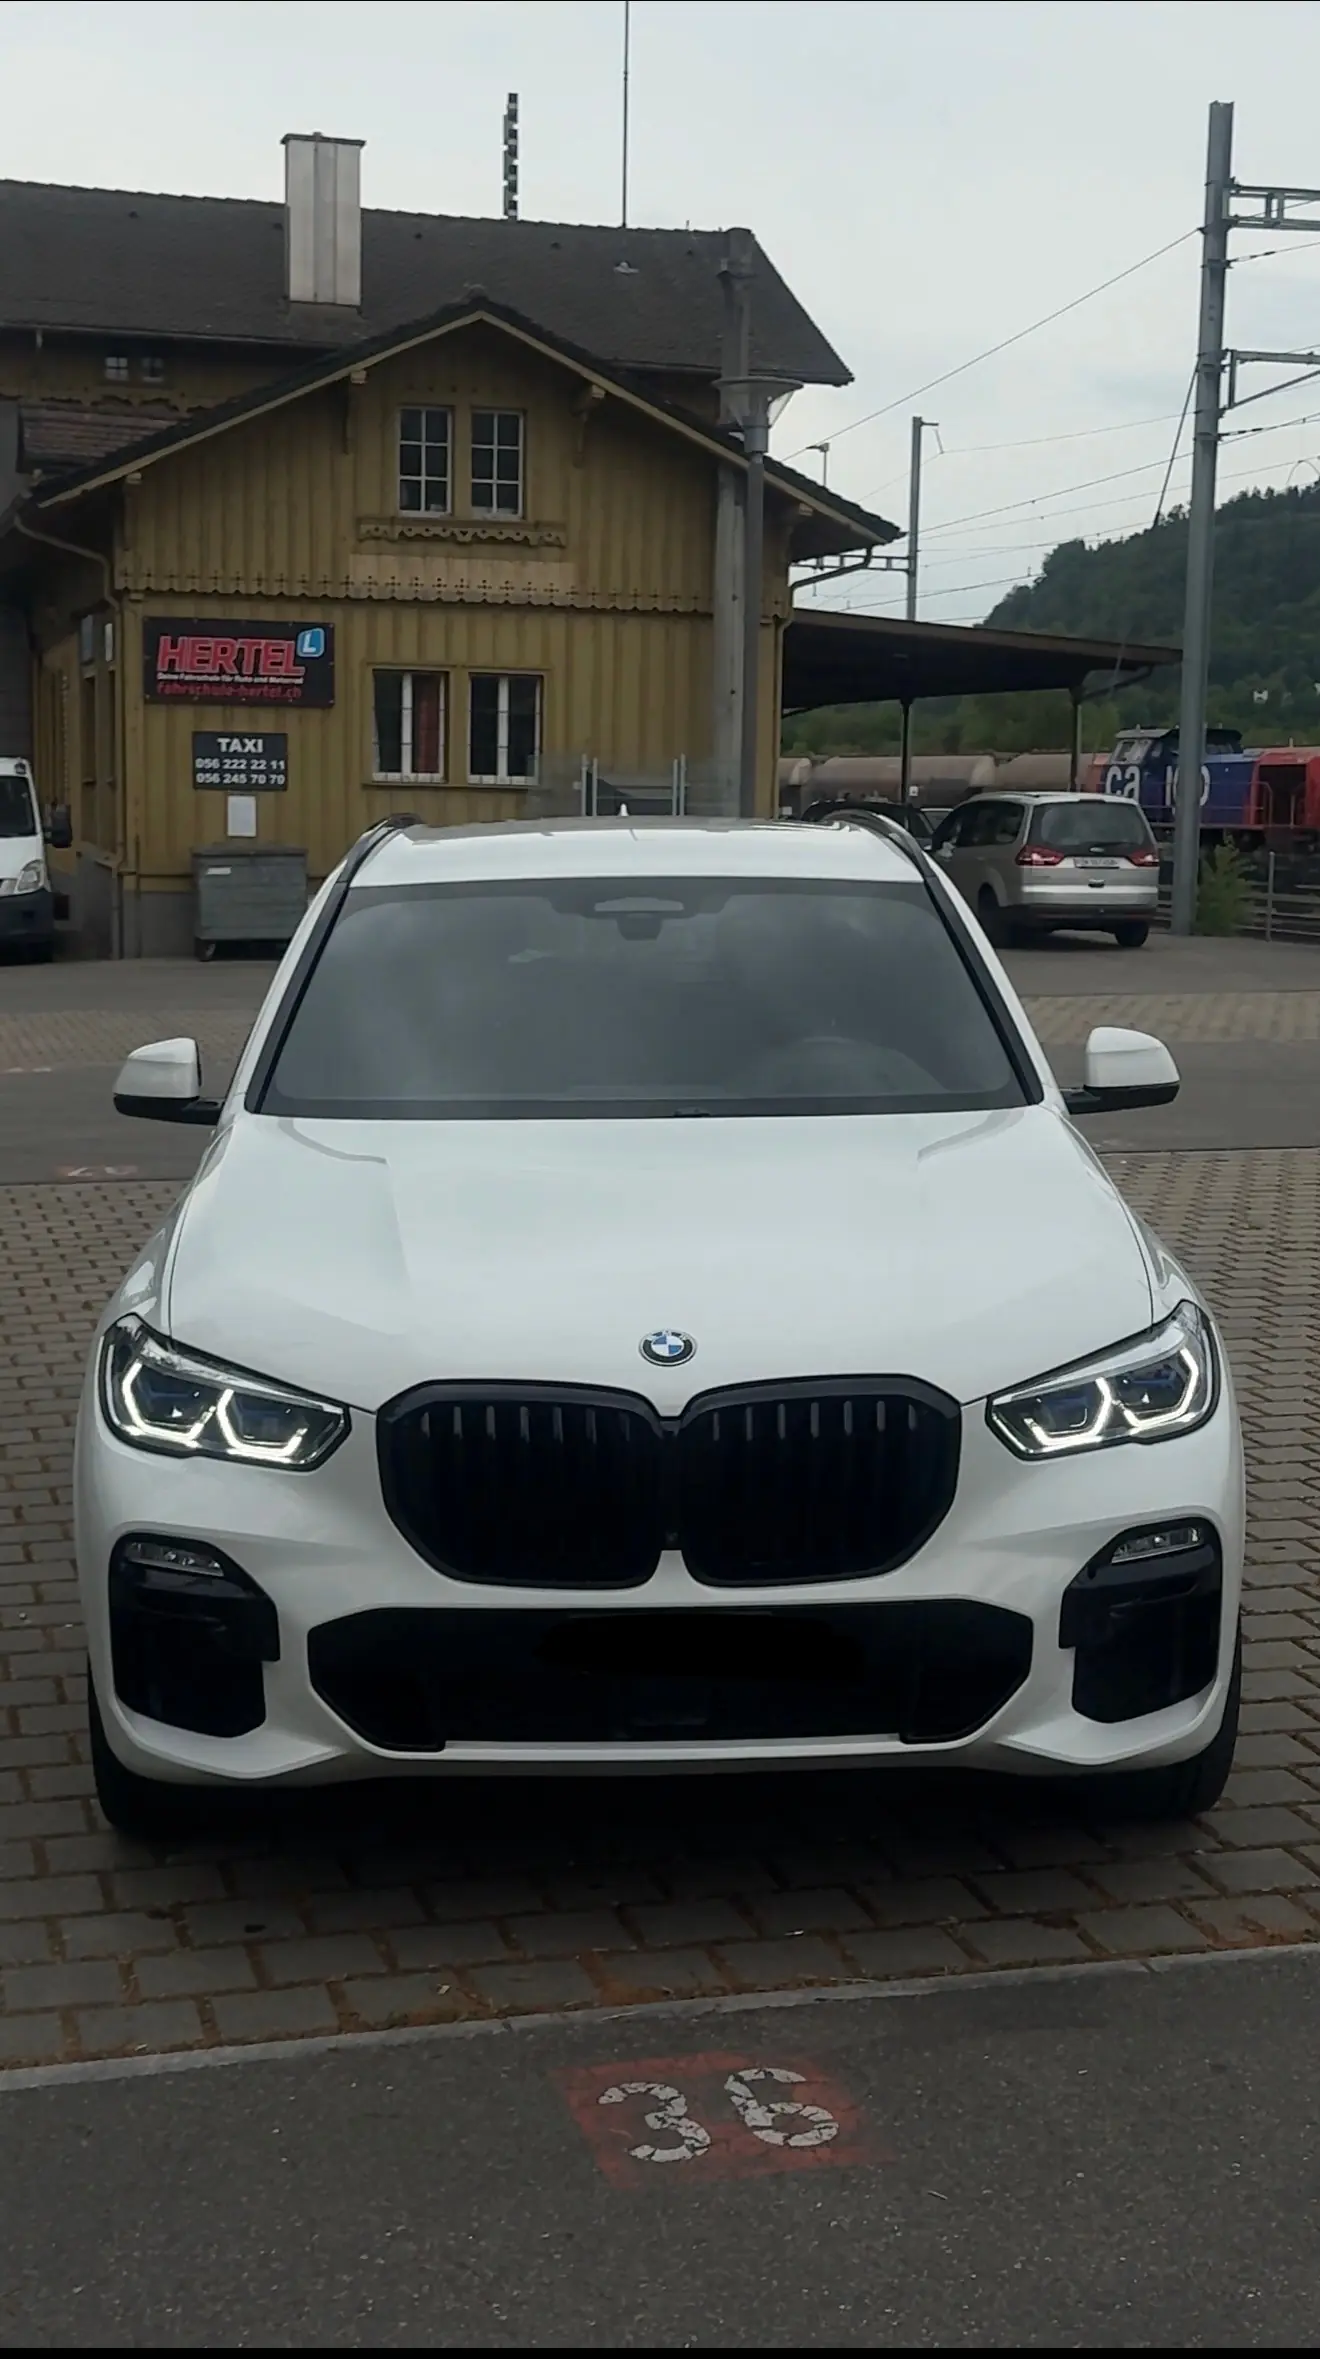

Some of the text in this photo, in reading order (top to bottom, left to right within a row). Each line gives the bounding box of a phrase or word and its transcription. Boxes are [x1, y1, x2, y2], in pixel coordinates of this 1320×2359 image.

[302, 633, 316, 653] L
[157, 635, 305, 676] HERTEL
[217, 737, 263, 753] TAXI
[195, 758, 285, 770] 056 222 22 11
[196, 772, 286, 785] 056 245 70 70
[597, 2067, 840, 2163] 36
